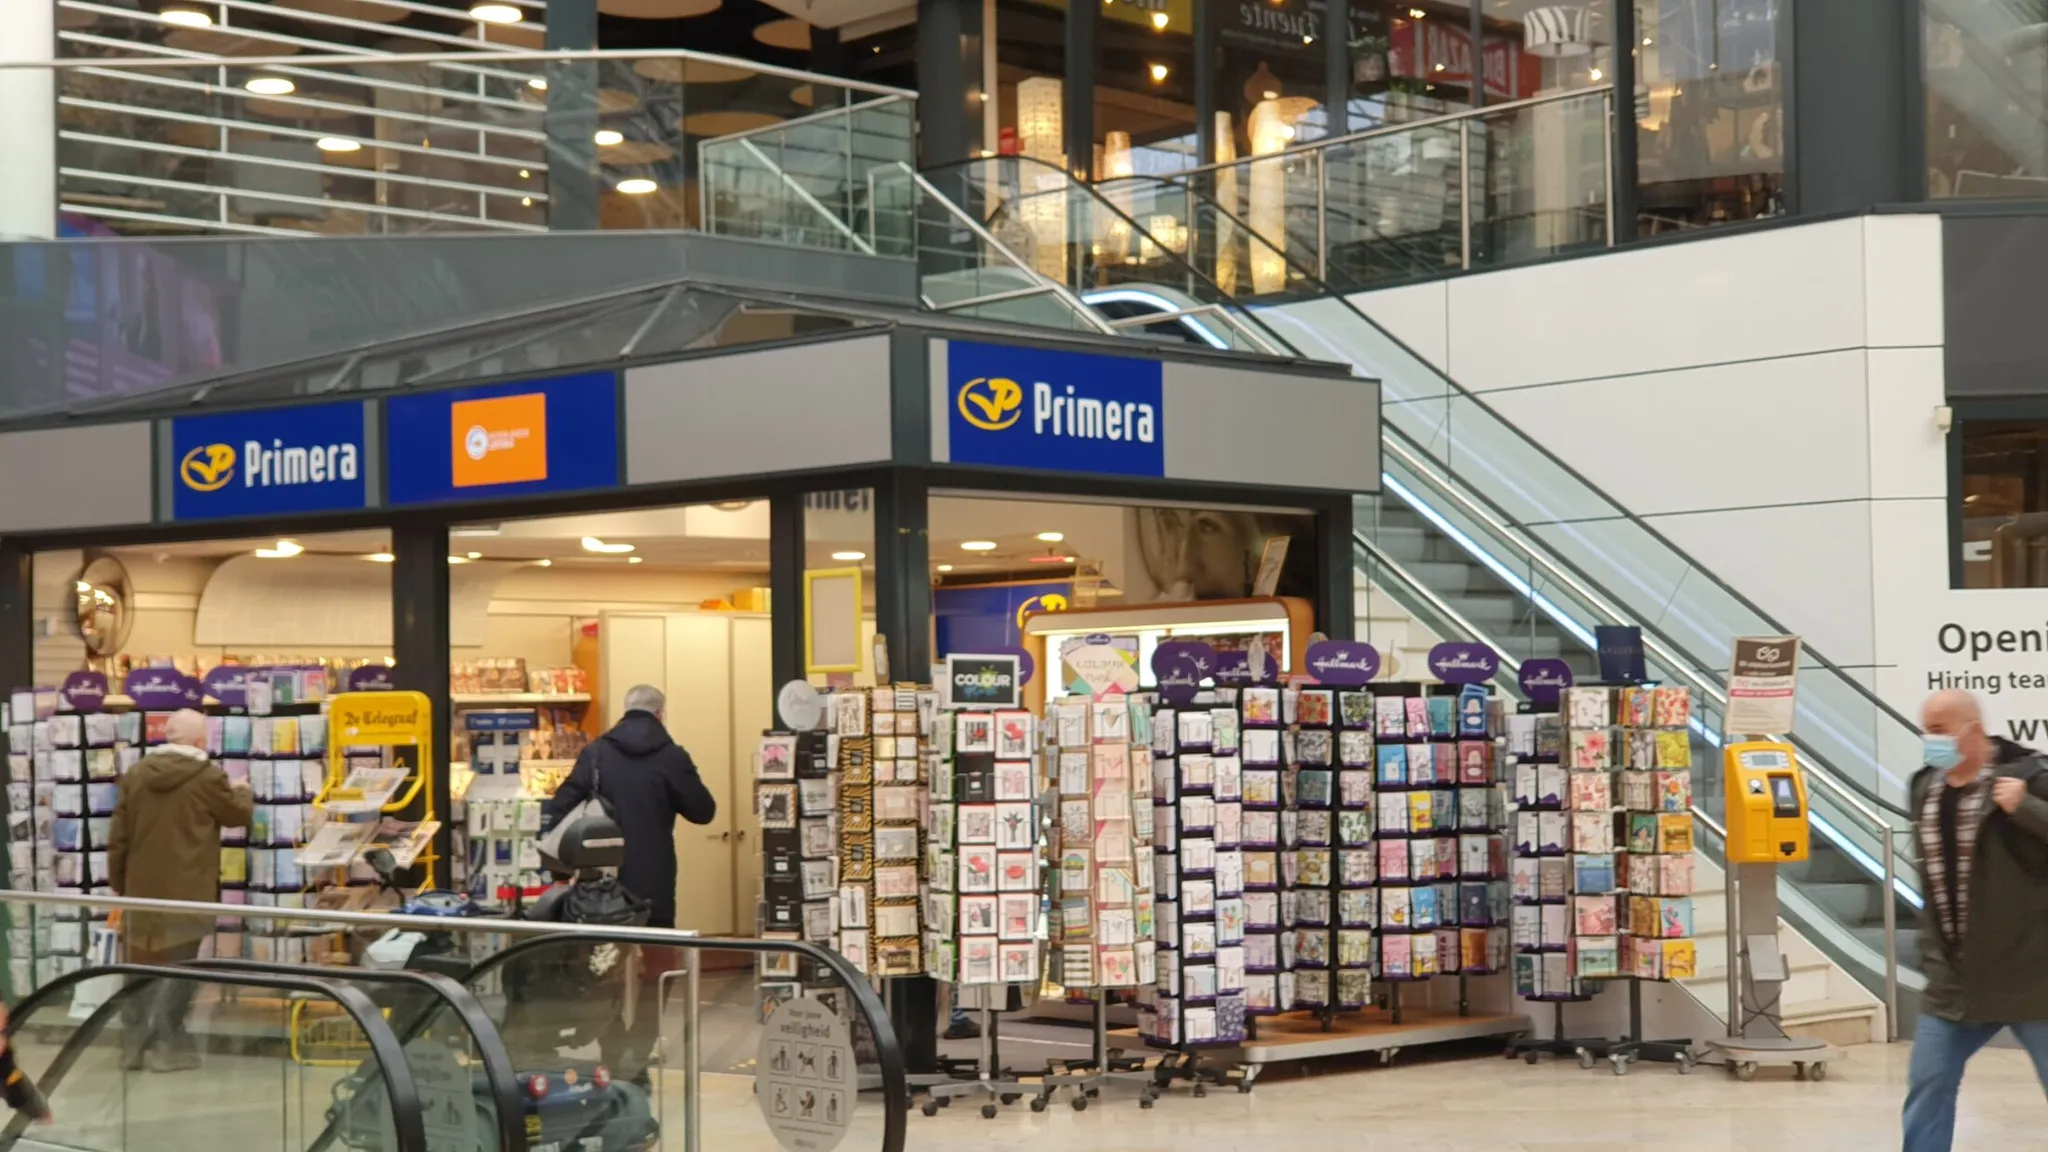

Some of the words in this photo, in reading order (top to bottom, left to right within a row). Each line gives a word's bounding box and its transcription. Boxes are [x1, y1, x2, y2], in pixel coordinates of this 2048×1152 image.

[1034, 382, 1155, 442] Primera
[244, 438, 358, 487] Primera
[1312, 655, 1373, 673] Hallmark
[1433, 656, 1492, 673] Hallmark
[954, 673, 1012, 689] COLOUR
[1160, 674, 1196, 690] Hallmark
[1523, 675, 1568, 692] Hallmark
[1927, 670, 2001, 695] Hiring
[2008, 671, 2048, 690] tea
[780, 1022, 831, 1039] veiligheid
